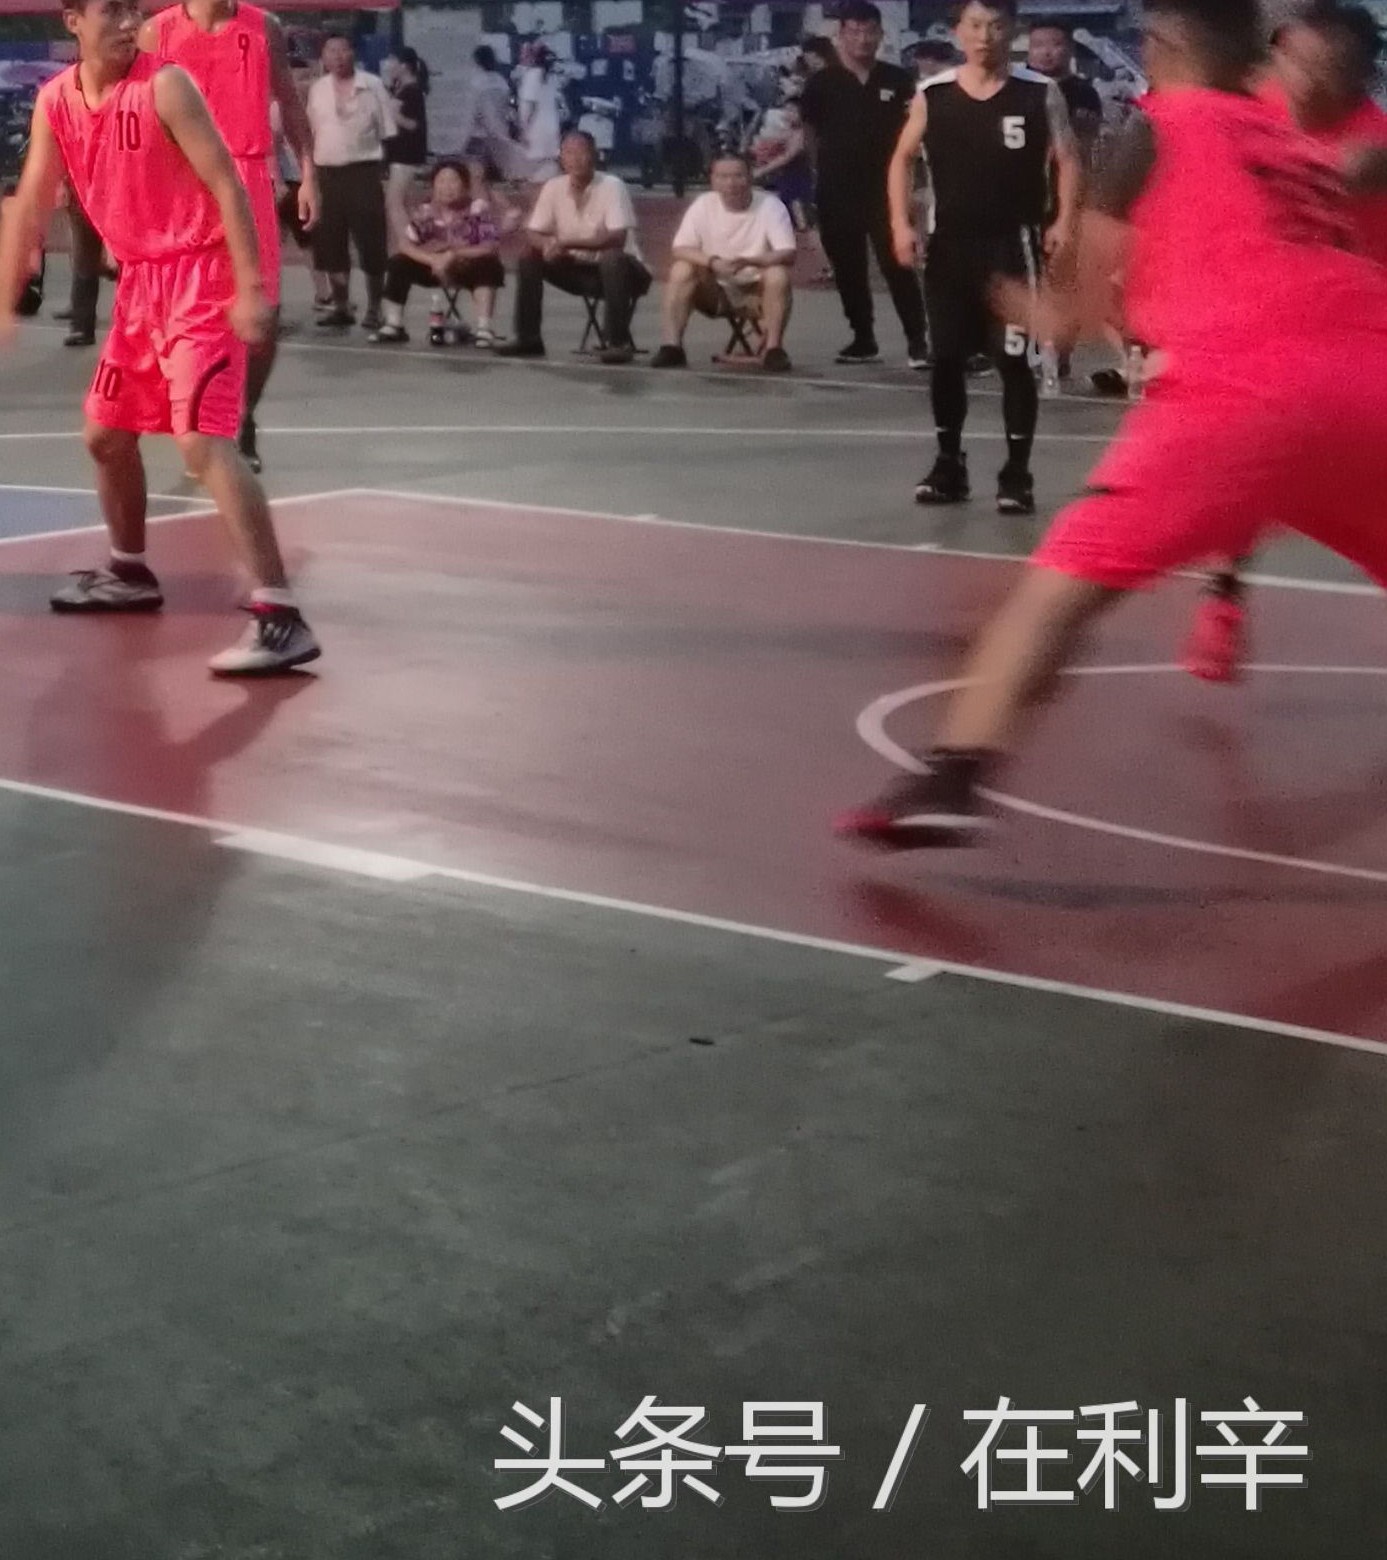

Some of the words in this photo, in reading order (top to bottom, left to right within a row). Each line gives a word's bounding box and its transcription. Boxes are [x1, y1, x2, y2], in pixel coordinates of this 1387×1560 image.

[238, 33, 250, 61] 9
[116, 110, 141, 152] 10
[1002, 115, 1026, 149] 5
[1004, 323, 1027, 357] 5
[90, 358, 124, 402] 10
